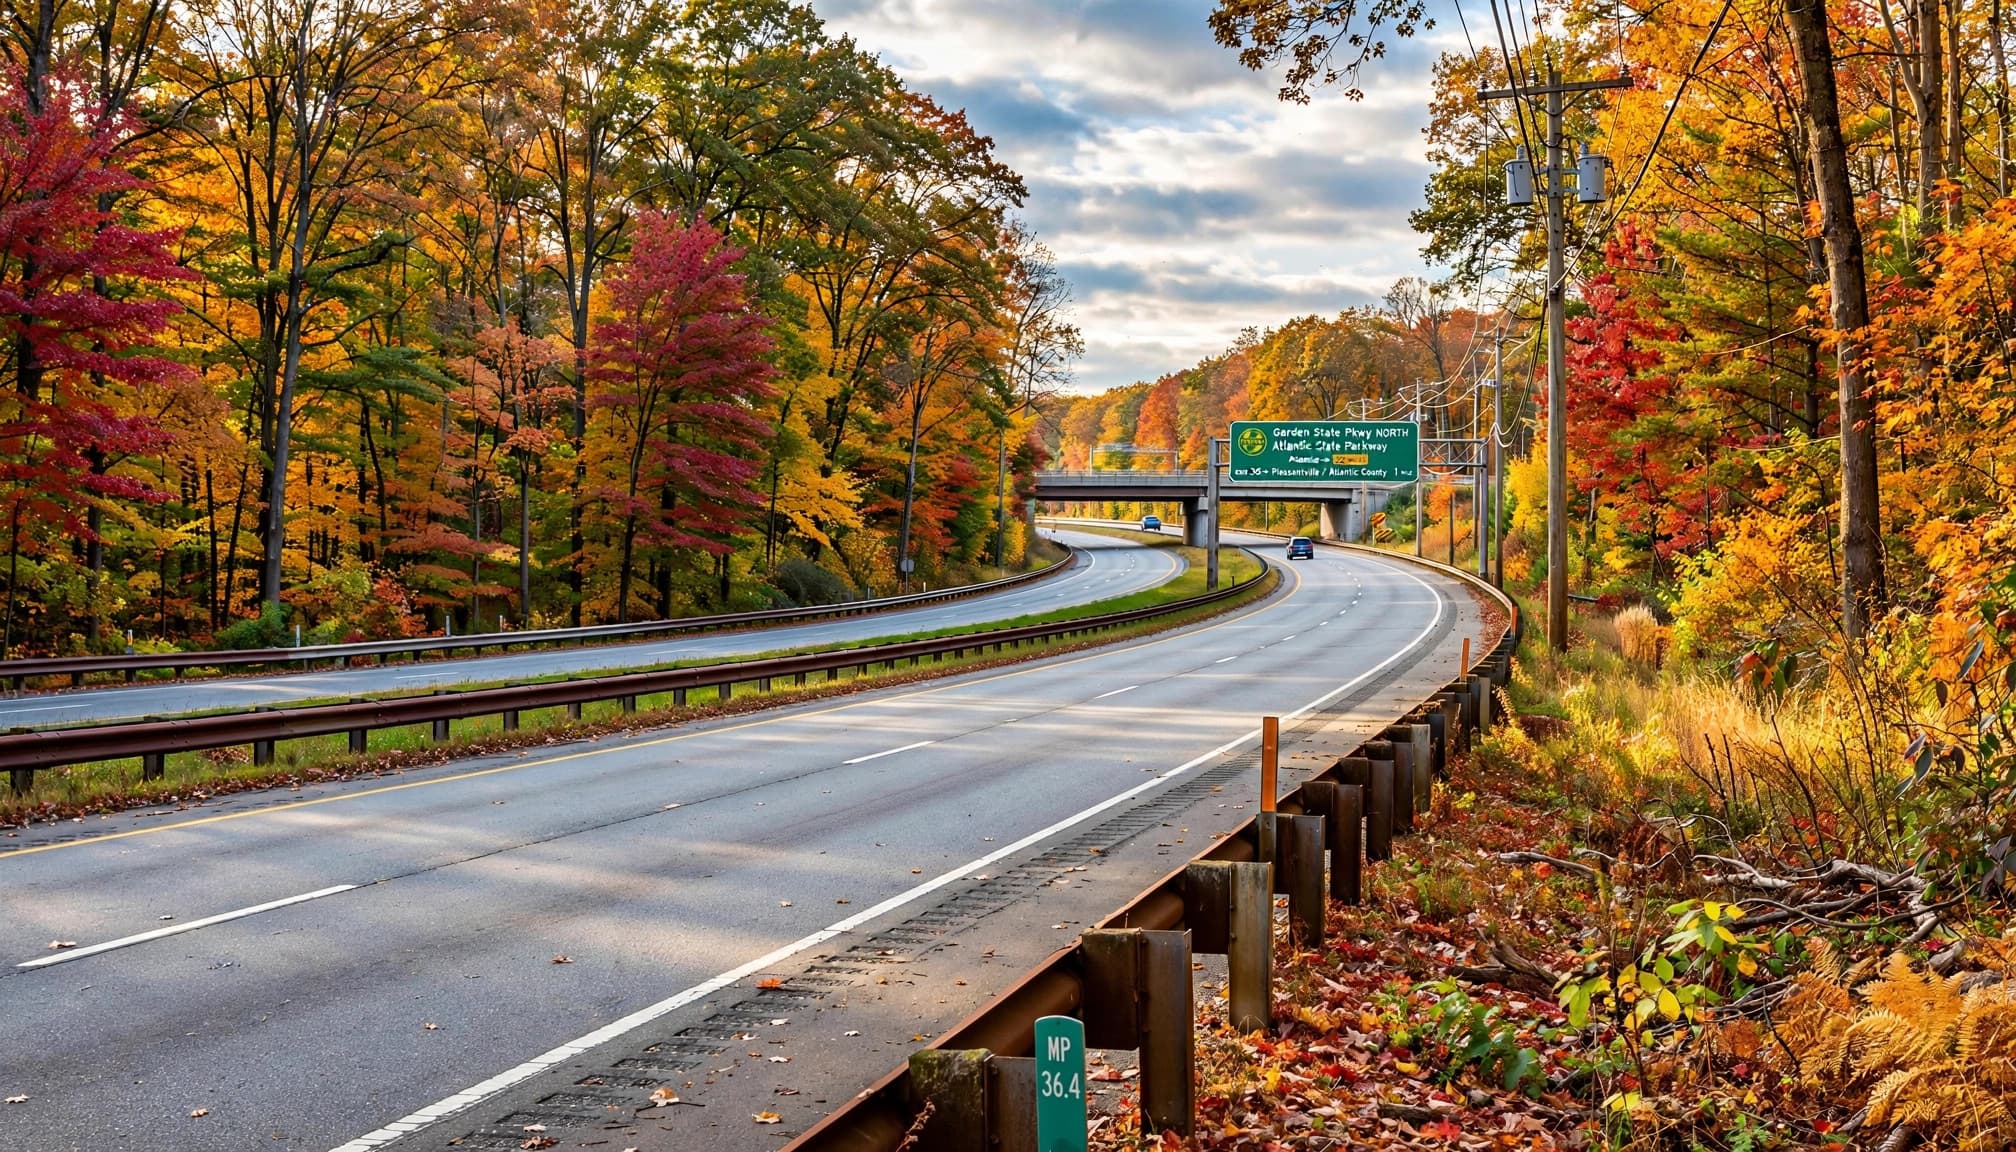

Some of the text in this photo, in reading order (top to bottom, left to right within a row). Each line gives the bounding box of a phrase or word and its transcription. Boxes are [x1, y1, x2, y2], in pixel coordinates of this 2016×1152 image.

[1273, 427, 1409, 440] Garden State Pkwy NORTH
[1272, 440, 1312, 451] Atlantic
[1329, 468, 1359, 476] Atlantic
[1361, 468, 1388, 478] County
[1047, 1036, 1071, 1062] MP
[1041, 1070, 1081, 1099] 36.4
